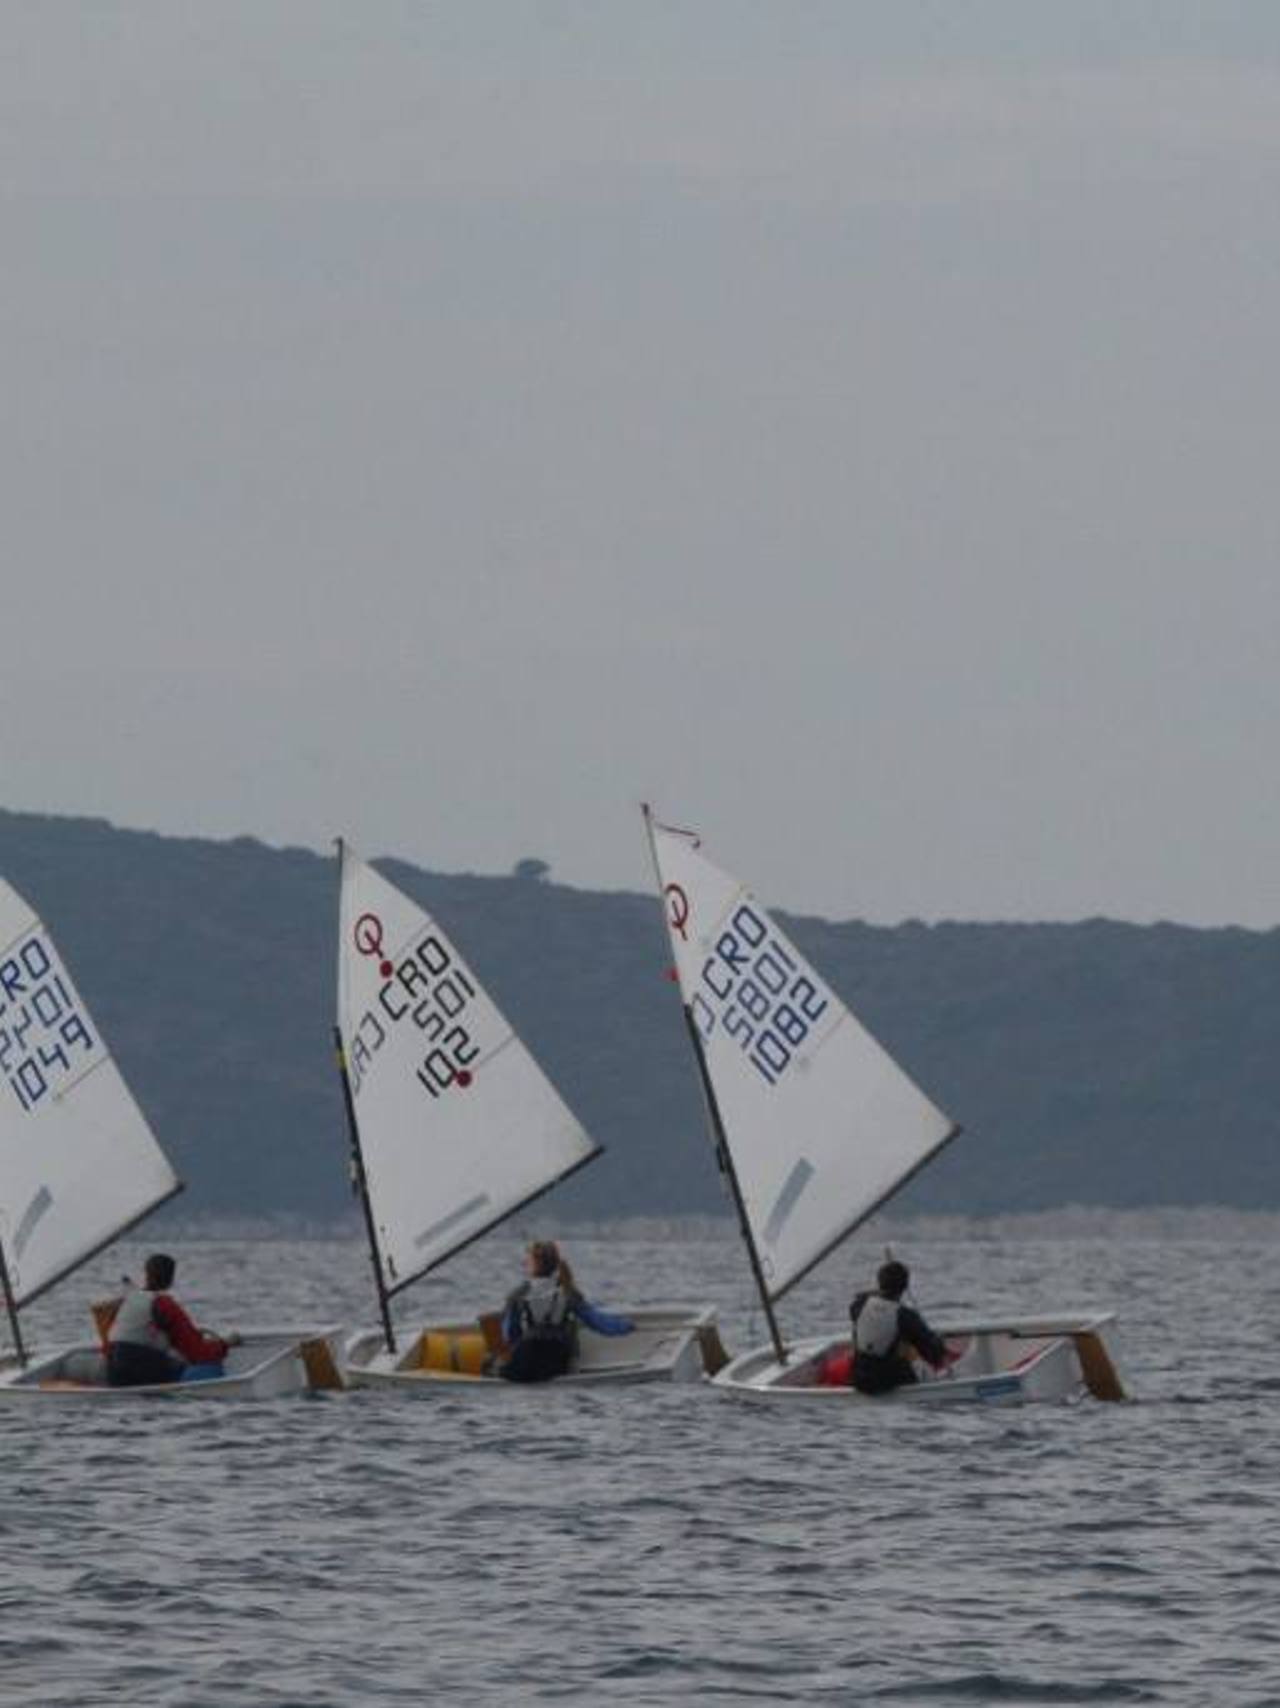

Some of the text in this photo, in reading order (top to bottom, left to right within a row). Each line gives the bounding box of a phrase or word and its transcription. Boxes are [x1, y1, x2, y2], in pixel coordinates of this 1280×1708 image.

[0, 938, 51, 1014] RO
[379, 936, 451, 1021] CRO
[702, 905, 768, 1001] CRO
[10, 1014, 93, 1111] 1049
[417, 1025, 482, 1098] 102
[749, 976, 828, 1086] 1082
